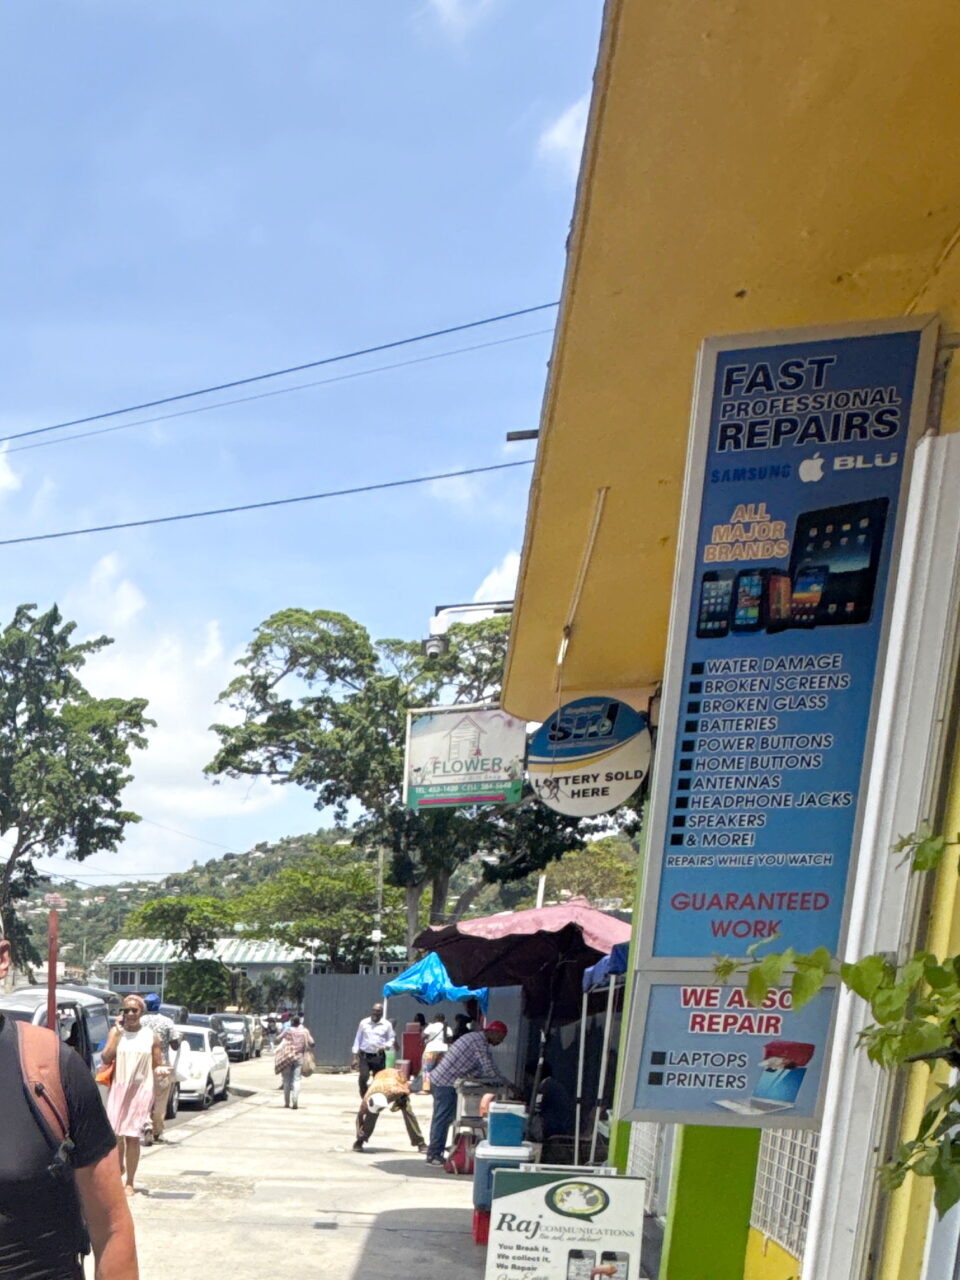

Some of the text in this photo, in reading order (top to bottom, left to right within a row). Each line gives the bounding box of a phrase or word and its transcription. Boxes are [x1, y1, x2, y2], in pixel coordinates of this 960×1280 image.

[723, 356, 835, 396] FAST
[721, 387, 901, 419] PROFESSIONAL
[717, 408, 900, 451] REPAIRS
[711, 464, 792, 483] SAMSUNG
[730, 503, 770, 523] ALL
[712, 521, 786, 543] MAJOR
[704, 540, 789, 562] BRANDS
[707, 654, 842, 674] WATER DAMAGE
[704, 674, 850, 694] BROKEN SCREENS
[702, 695, 828, 713] BROKEN GLASS
[700, 716, 777, 732] BATTERIES
[697, 734, 833, 751] POWER BUTTONS
[695, 754, 822, 771] HOME BUTTONS
[535, 769, 644, 788] LOTTERY SOLD
[693, 775, 781, 790] ANTENNAS
[571, 787, 610, 799] HERE
[690, 792, 853, 809] HEADPHONE JACKS
[688, 814, 766, 829] SPEAKERS
[686, 832, 755, 847] & MORE!
[667, 853, 833, 867] REPAIRS WHILE YOU WATCH
[671, 892, 830, 911] GUARANTEED
[711, 920, 783, 938] WORK
[680, 986, 797, 1010] WE ASO
[688, 1013, 783, 1036] REPAIR
[668, 1052, 748, 1069] LAPTOPS
[666, 1072, 746, 1089] PRINTERS
[496, 1212, 635, 1239] Raj COMMUNICATIONS
[516, 1244, 539, 1252] Break
[512, 1254, 540, 1262] collect
[511, 1263, 538, 1272] Repair
